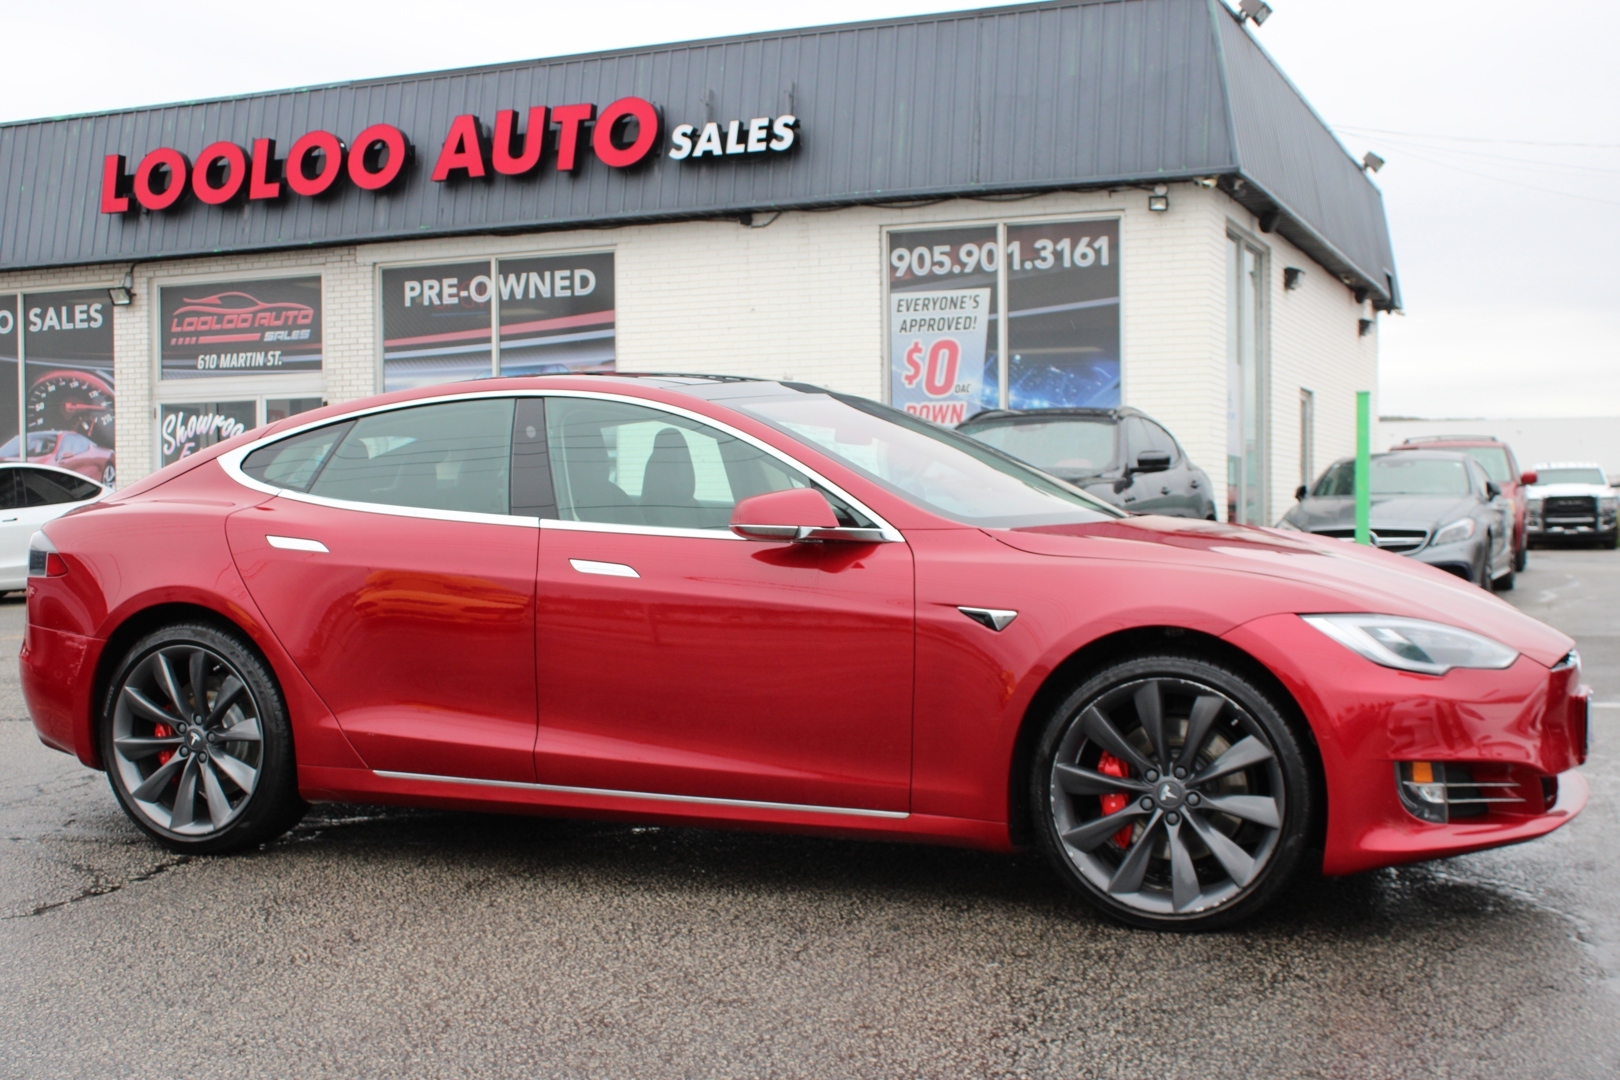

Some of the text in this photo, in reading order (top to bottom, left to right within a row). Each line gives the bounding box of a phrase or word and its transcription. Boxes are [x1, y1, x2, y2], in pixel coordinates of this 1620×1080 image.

[101, 96, 797, 214] LOOLOO AUTO SALES
[890, 235, 1109, 277] 905.901.3161
[404, 269, 596, 307] PRE-OWNED
[29, 303, 103, 332] SALES
[896, 294, 980, 313] EVERYONE'S
[171, 309, 314, 332] LOOLOO AUTO
[899, 315, 977, 333] APPROVED!
[263, 329, 311, 342] SALES
[197, 351, 282, 369] 610 MARTIN ST.
[904, 339, 971, 395] $0 OAC
[162, 411, 247, 455] Showroo
